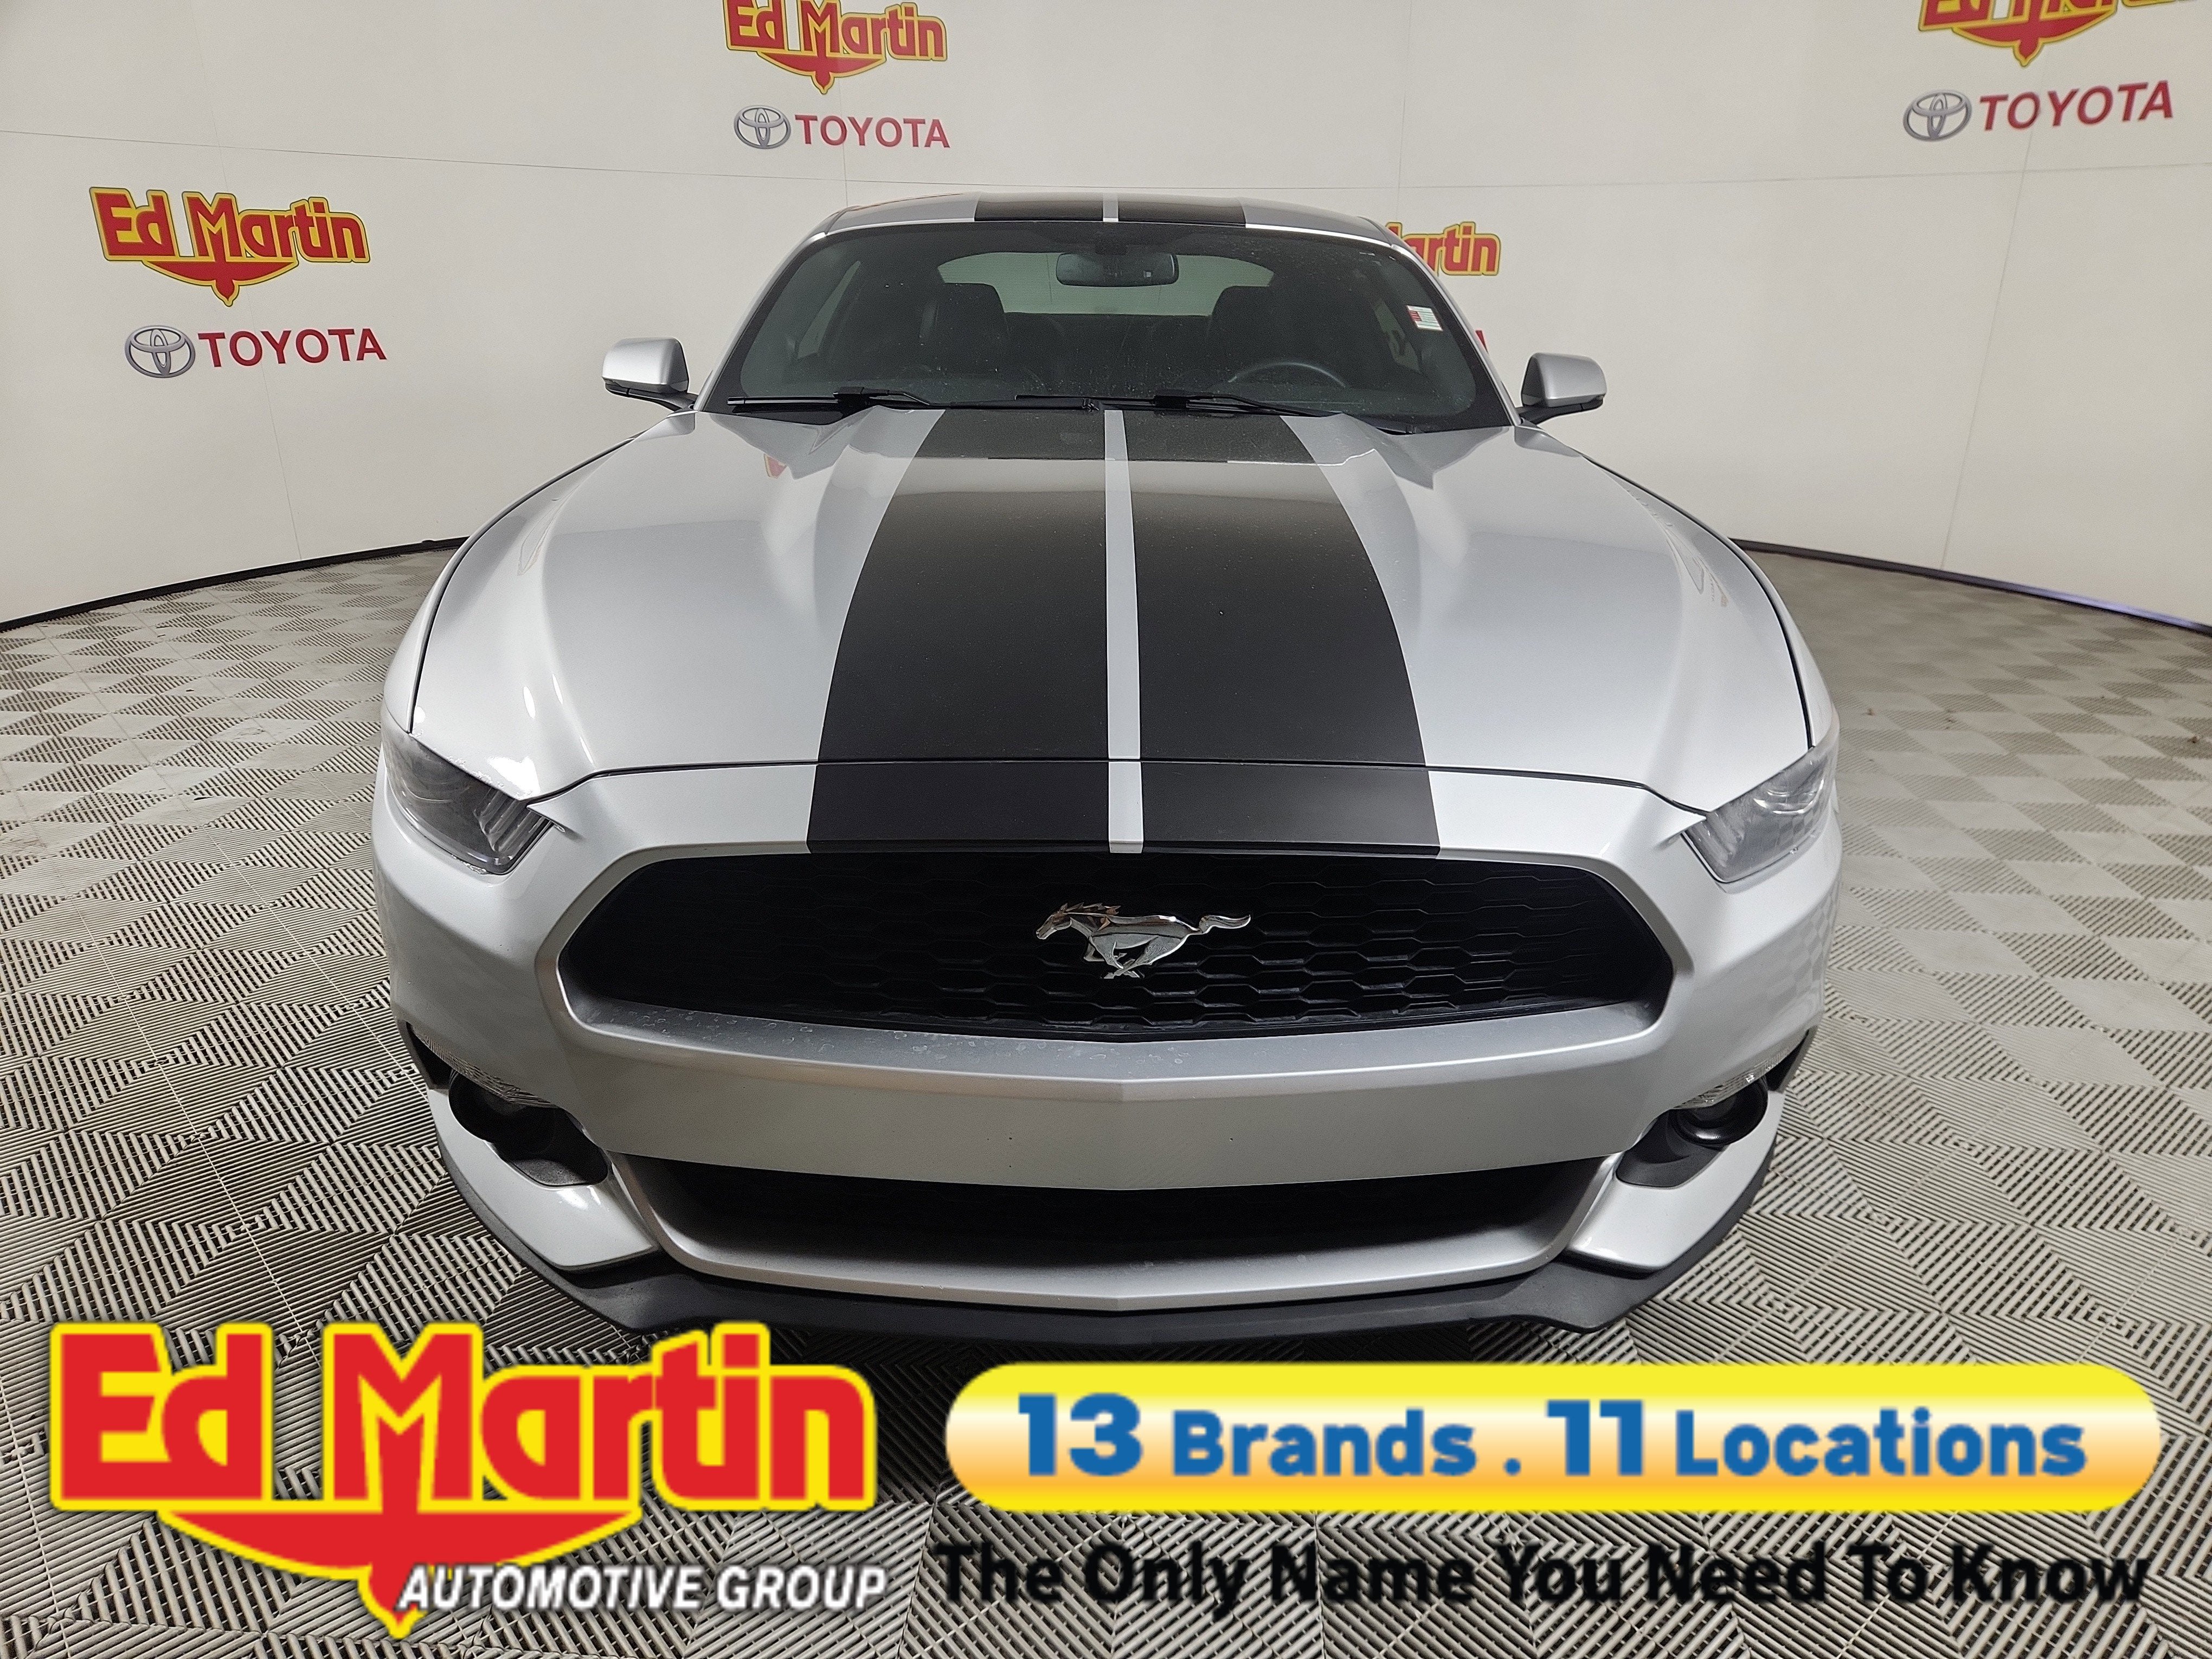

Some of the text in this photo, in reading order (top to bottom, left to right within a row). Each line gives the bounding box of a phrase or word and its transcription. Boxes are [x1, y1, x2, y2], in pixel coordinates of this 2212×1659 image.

[727, 0, 945, 58] Ed Martin
[1979, 80, 2173, 131] TOYOTA
[795, 114, 950, 149] TOYOTA
[94, 192, 367, 259] Ed Martin
[1388, 225, 1497, 272] rtin
[197, 328, 387, 368] TOYOTA
